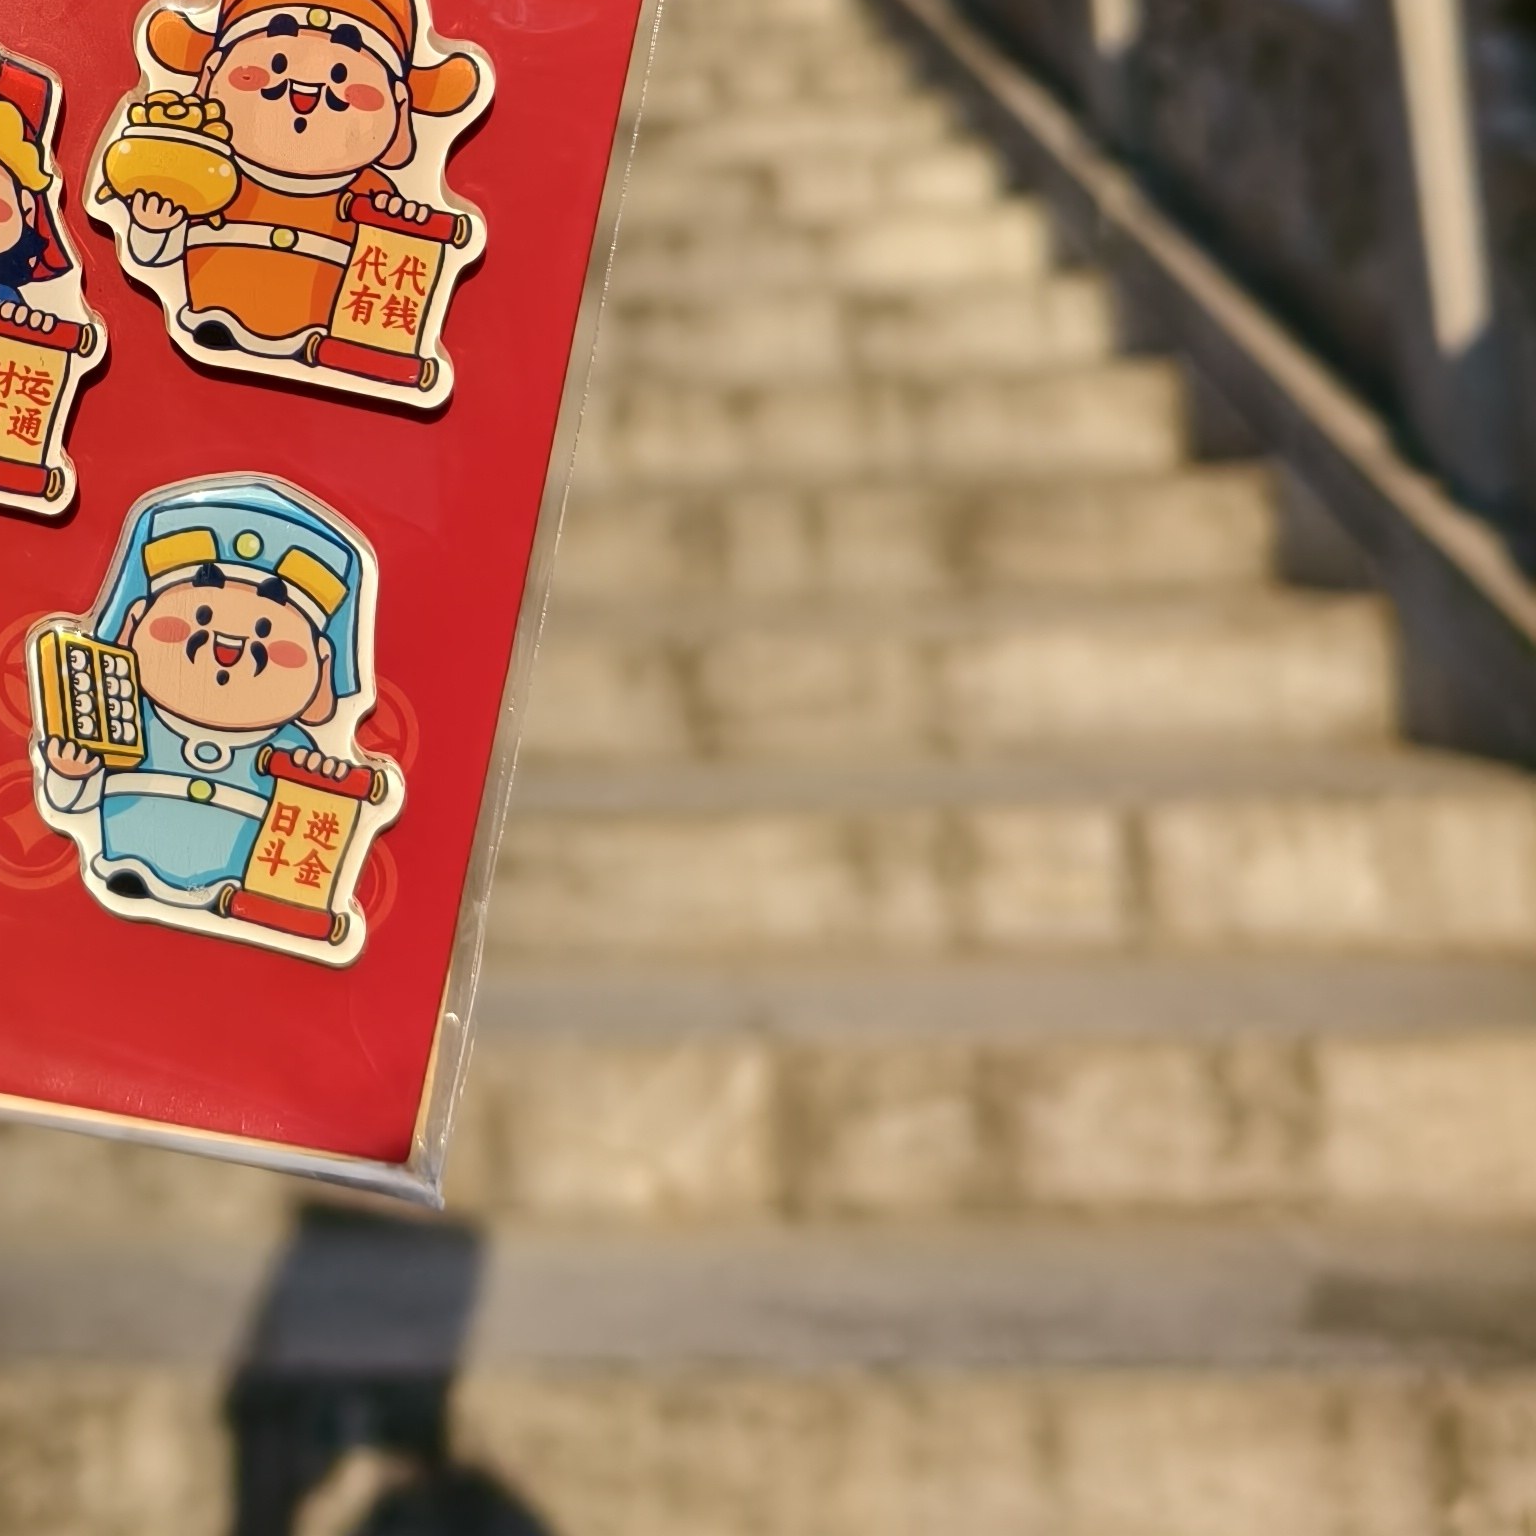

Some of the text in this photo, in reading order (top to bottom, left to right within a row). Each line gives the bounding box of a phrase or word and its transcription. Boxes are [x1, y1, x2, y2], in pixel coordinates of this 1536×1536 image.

[351, 244, 427, 297] 代代
[342, 284, 419, 336] 有钱
[270, 801, 340, 851] 日进
[256, 838, 332, 889] 斗金
